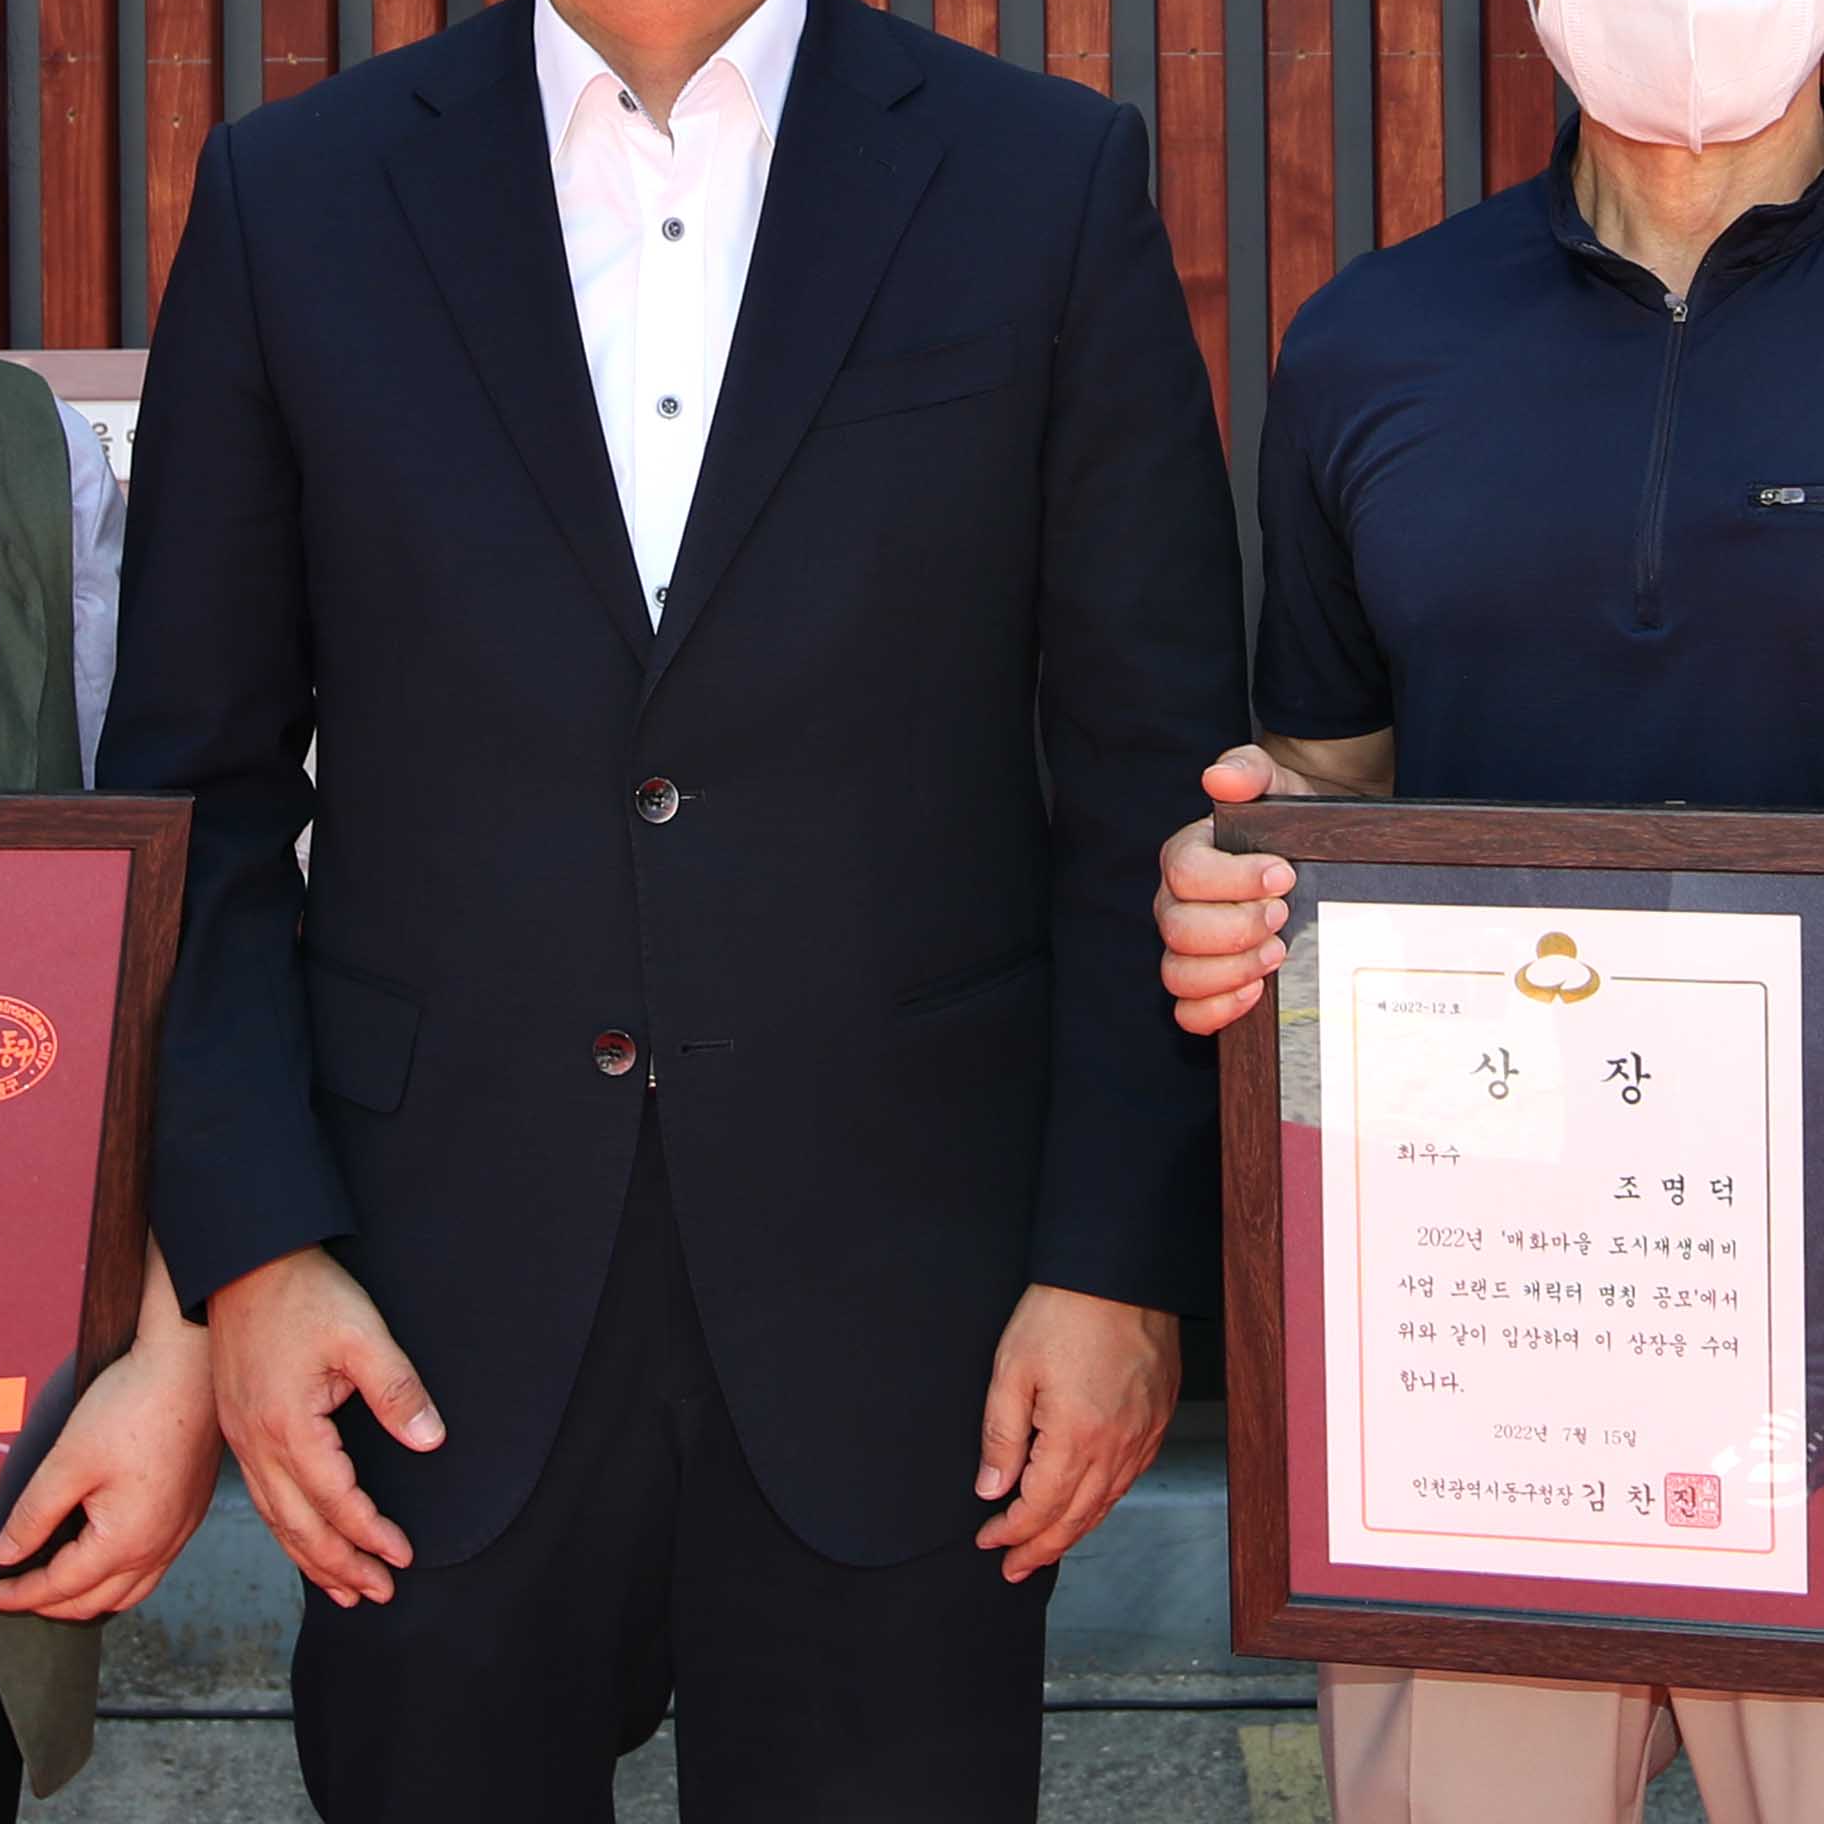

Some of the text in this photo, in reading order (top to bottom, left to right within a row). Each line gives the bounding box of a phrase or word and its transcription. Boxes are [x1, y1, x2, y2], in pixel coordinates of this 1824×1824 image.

[1397, 1142, 1461, 1166] 최우수
[1417, 1226, 1737, 1261] 2022년 '매화마을 도시재생예비
[1399, 1275, 1738, 1312] 사업 브랜드 캐릭터 명칭 공모'에서
[1399, 1321, 1739, 1358] 위와 같이 입상하여 이 상장을 수여
[1400, 1369, 1465, 1393] 합니다.
[1493, 1423, 1638, 1448] 2022년 7월 15일
[1412, 1475, 1574, 1507] 인천광역시동구청장
